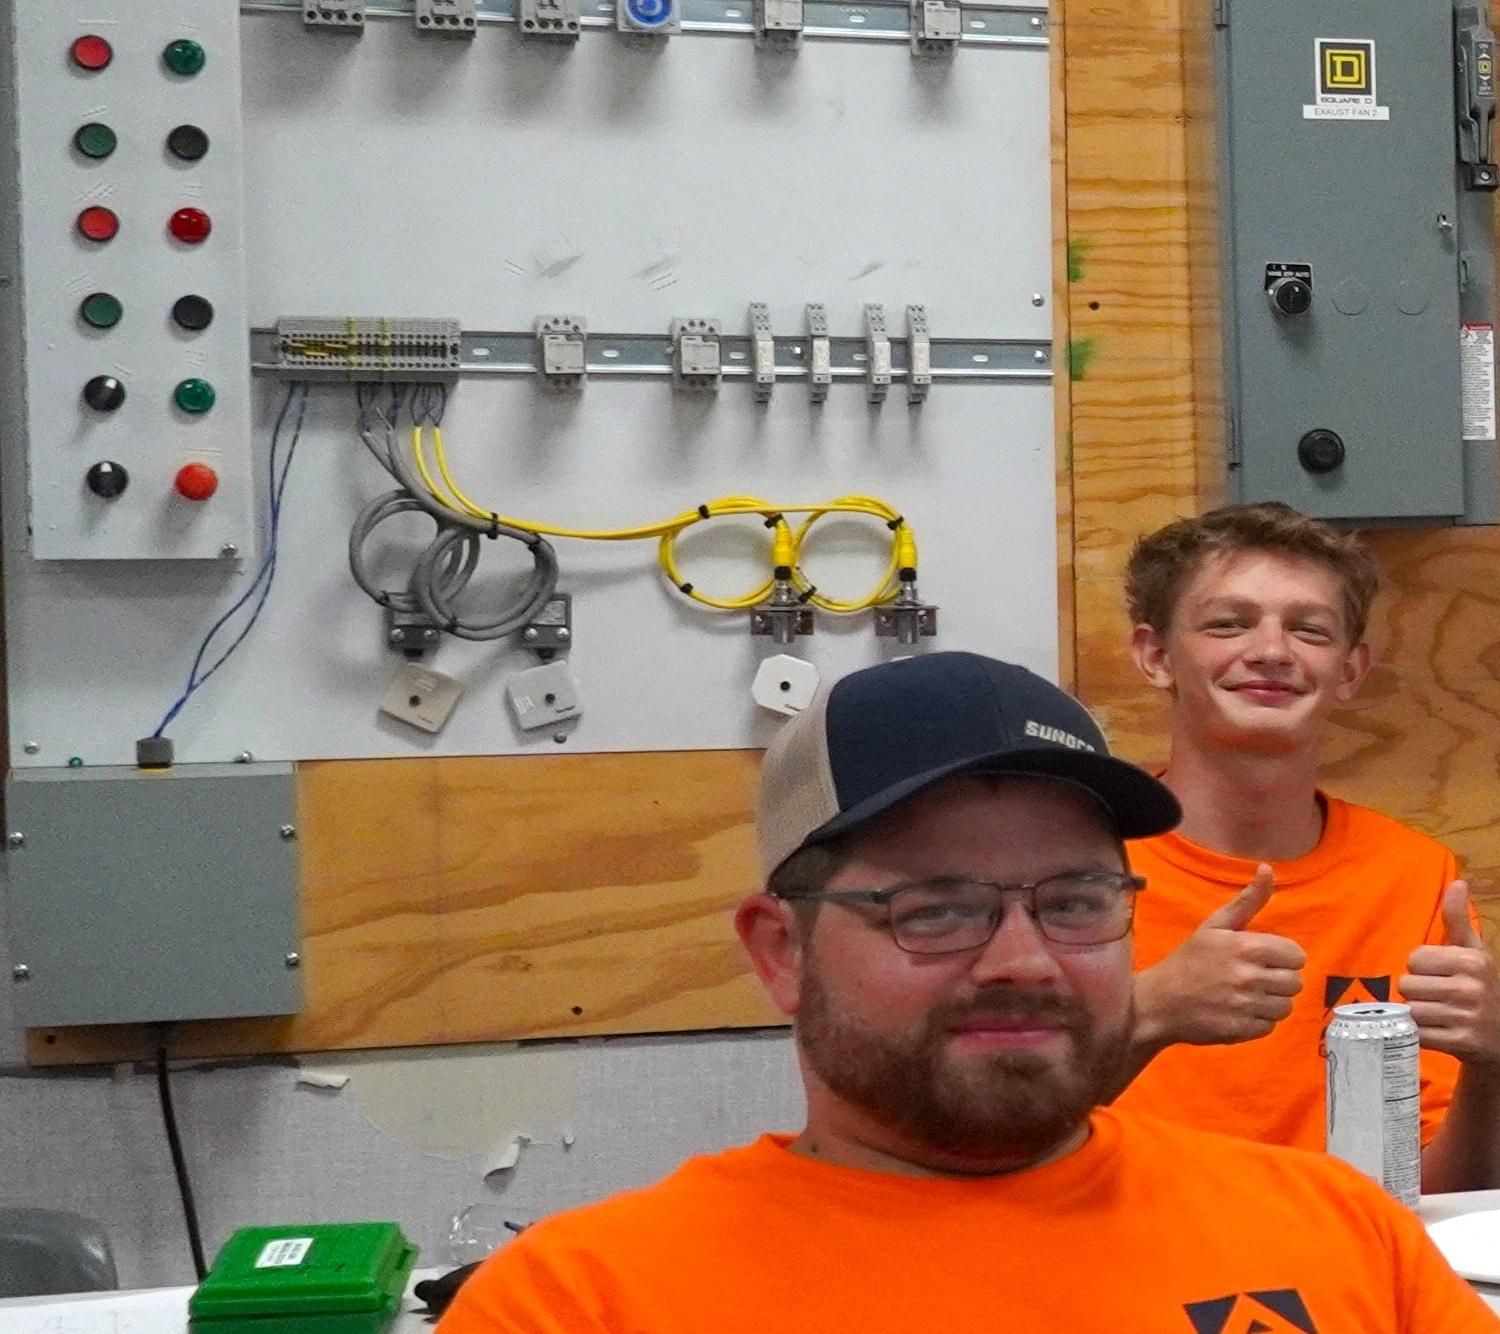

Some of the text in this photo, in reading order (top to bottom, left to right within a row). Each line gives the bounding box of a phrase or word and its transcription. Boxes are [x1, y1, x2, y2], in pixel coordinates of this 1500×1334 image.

[1320, 96, 1373, 105] SQUARE D
[1314, 107, 1350, 117] EXAUST
[1352, 108, 1371, 117] FAN
